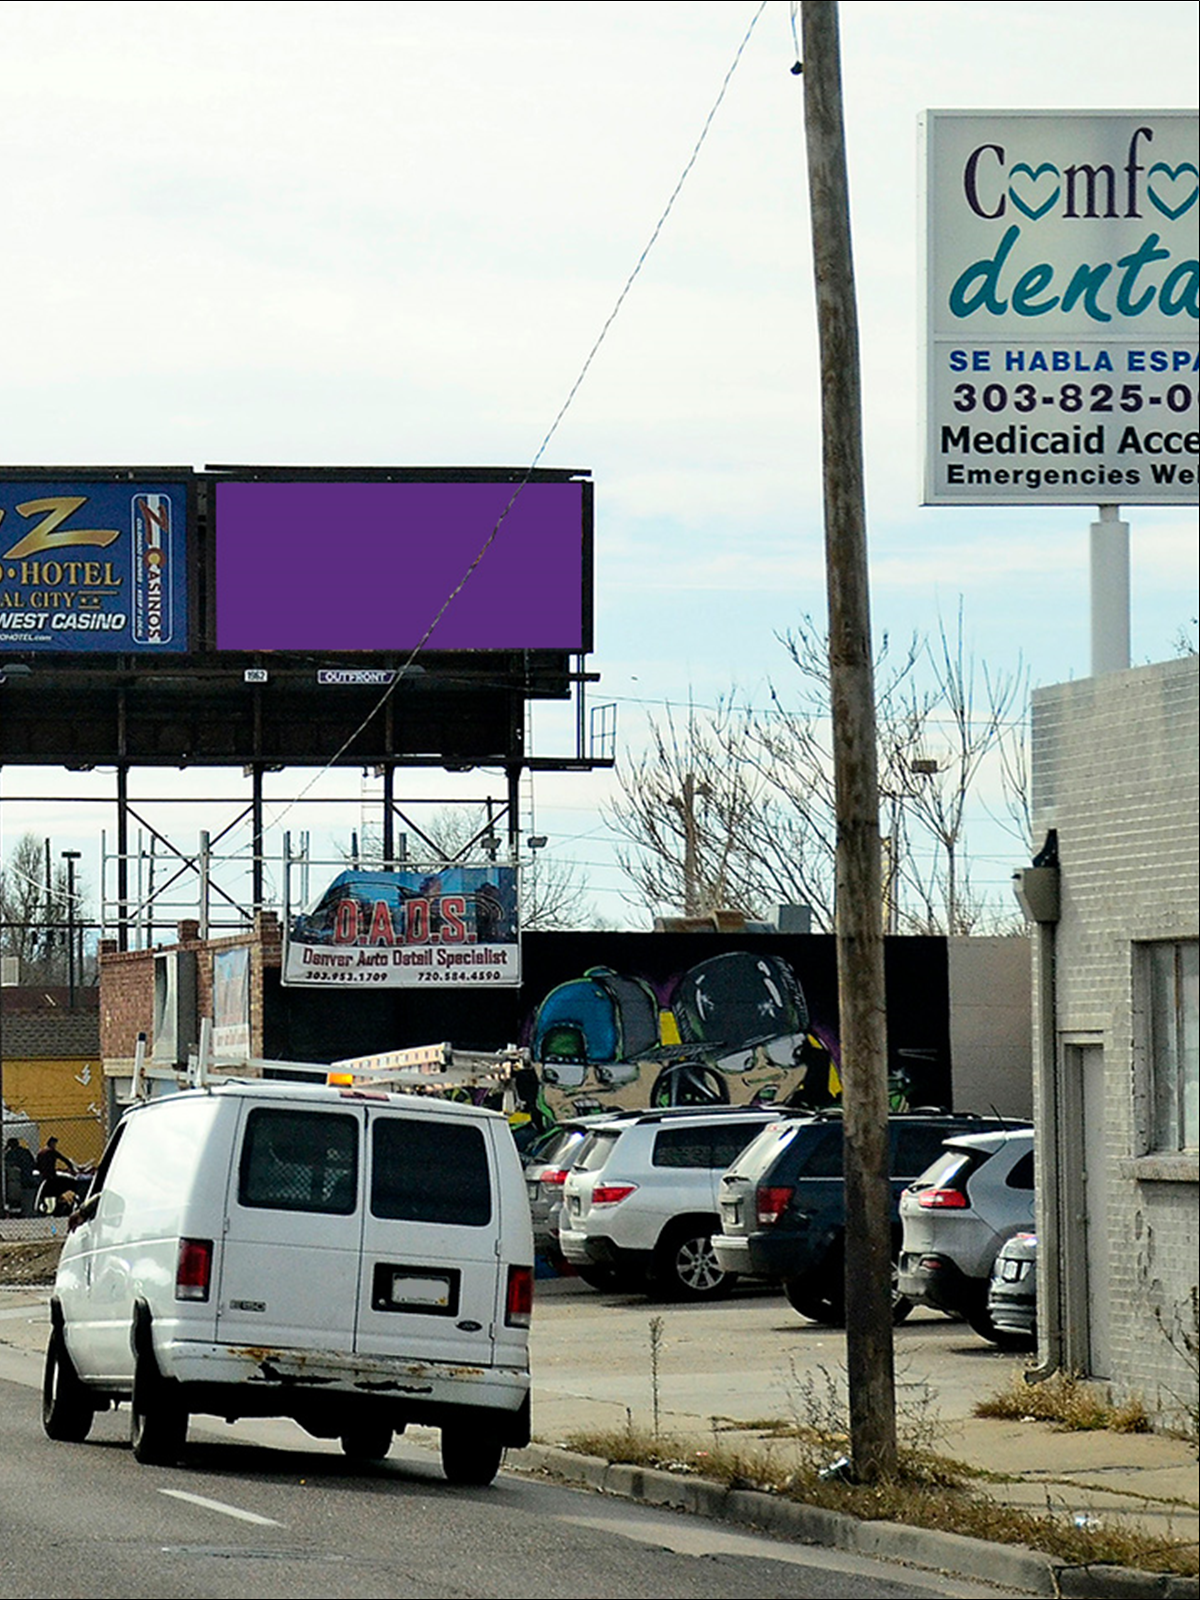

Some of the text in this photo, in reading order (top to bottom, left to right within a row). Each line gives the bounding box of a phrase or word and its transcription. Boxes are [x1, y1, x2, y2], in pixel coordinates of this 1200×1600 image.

[949, 350, 991, 372] SE
[1005, 350, 1114, 372] HABLA
[952, 383, 1198, 413] 303-825-0
[941, 424, 1198, 455] Medicaid Acce
[947, 463, 1141, 489] Emergencies
[2, 496, 121, 560] Z
[20, 560, 122, 586] HOTEL
[30, 591, 77, 609] CITY
[144, 547, 166, 639] CASINOS
[51, 611, 127, 630] CASINO
[324, 671, 387, 683] OUTFRONT
[303, 948, 508, 969] Denver Auto Detail Specialist
